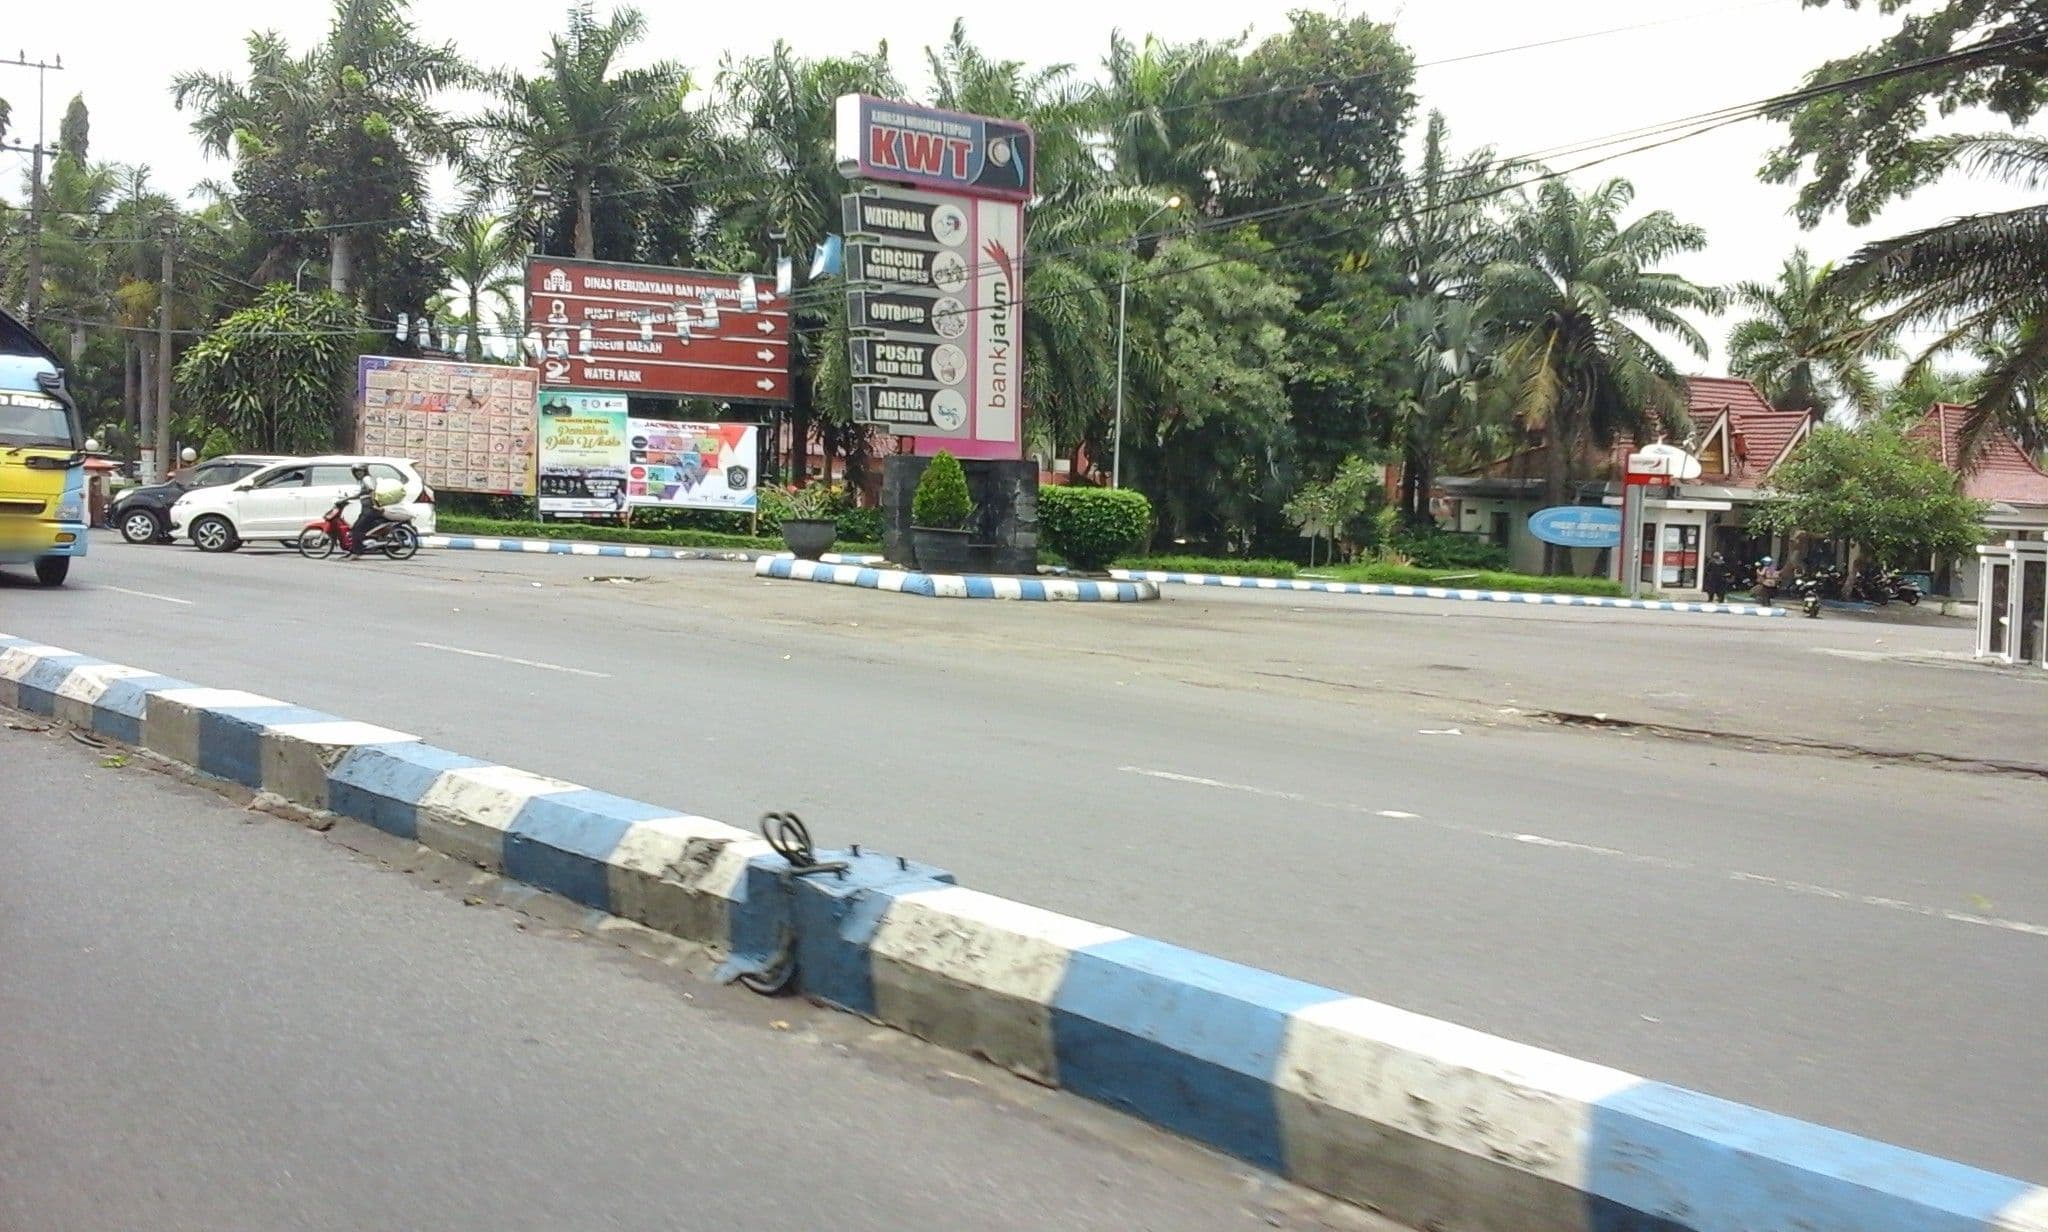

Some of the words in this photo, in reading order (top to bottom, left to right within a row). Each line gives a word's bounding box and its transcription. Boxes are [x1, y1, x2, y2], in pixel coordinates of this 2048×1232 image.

[870, 125, 973, 179] KWT
[864, 205, 926, 232] WATERPARK
[871, 248, 925, 270] CIRCUIT
[866, 264, 898, 281] MOTOR
[584, 277, 612, 290] DINAS
[614, 279, 673, 295] KEBUDAYAAN
[674, 284, 694, 298] DAN
[695, 286, 741, 301] PAWISAT
[584, 307, 615, 320] PUSAT
[616, 309, 665, 325] INFOASI
[592, 337, 625, 351] USEUM
[875, 344, 924, 363] PUSAT
[584, 368, 615, 381] WATER
[617, 369, 642, 383] PARK
[878, 391, 923, 410] ARENA
